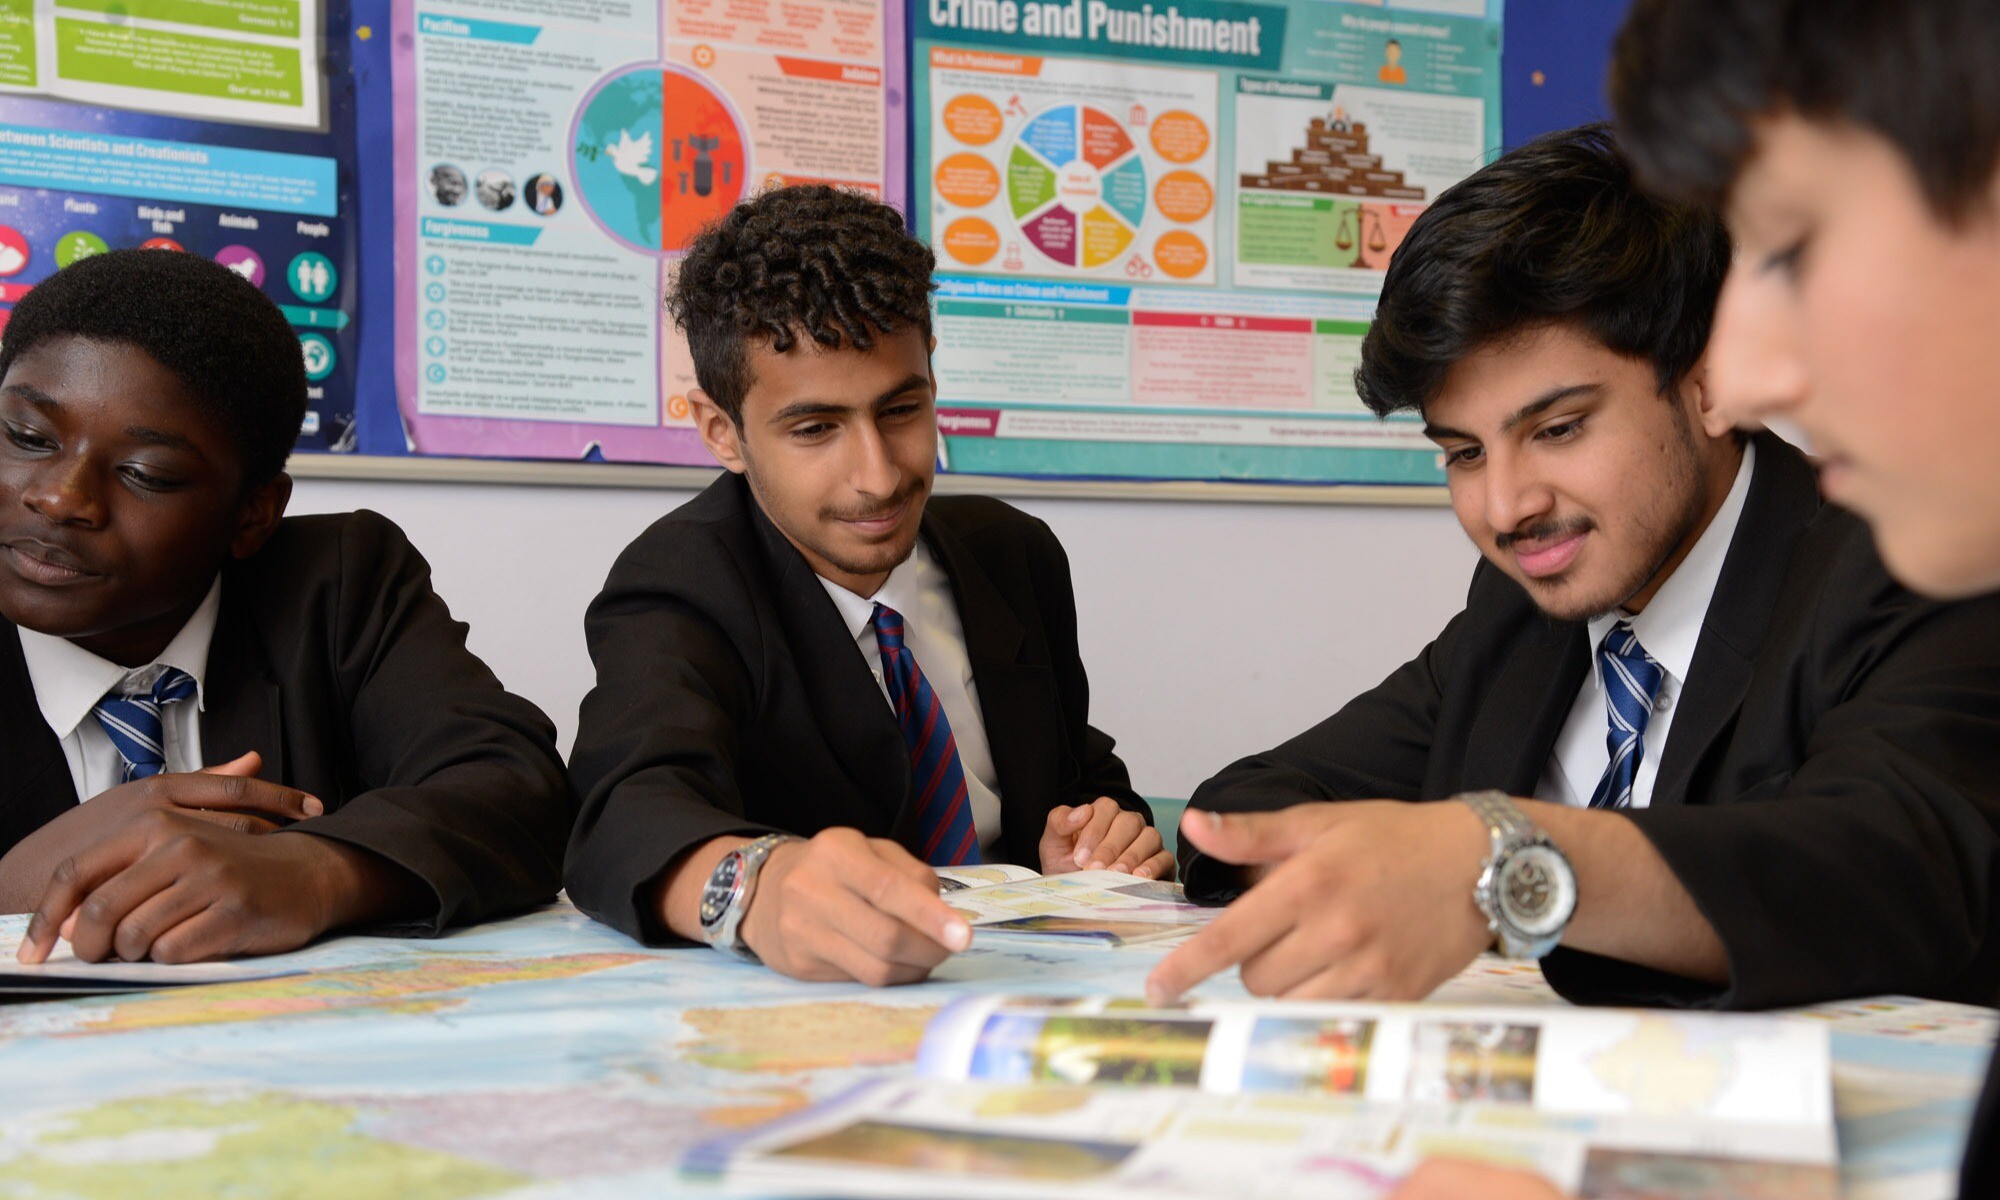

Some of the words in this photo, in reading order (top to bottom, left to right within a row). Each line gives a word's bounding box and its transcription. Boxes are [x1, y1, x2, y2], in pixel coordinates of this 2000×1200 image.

[423, 17, 470, 36] Pacifism
[929, 0, 1018, 34] Crime
[1022, 0, 1083, 38] and
[1088, 1, 1261, 56] Punishment
[933, 50, 953, 64] What
[966, 54, 1023, 72] Punishment?
[1273, 81, 1321, 96] Punishment
[49, 133, 109, 153] Scientists
[112, 142, 134, 156] and
[136, 142, 209, 165] Creationists
[64, 196, 98, 214] Plants
[138, 206, 163, 221] Birds
[218, 213, 259, 230] Animals
[297, 220, 330, 238] People
[426, 218, 489, 239] Forgiveness
[1058, 286, 1109, 302] Punishment
